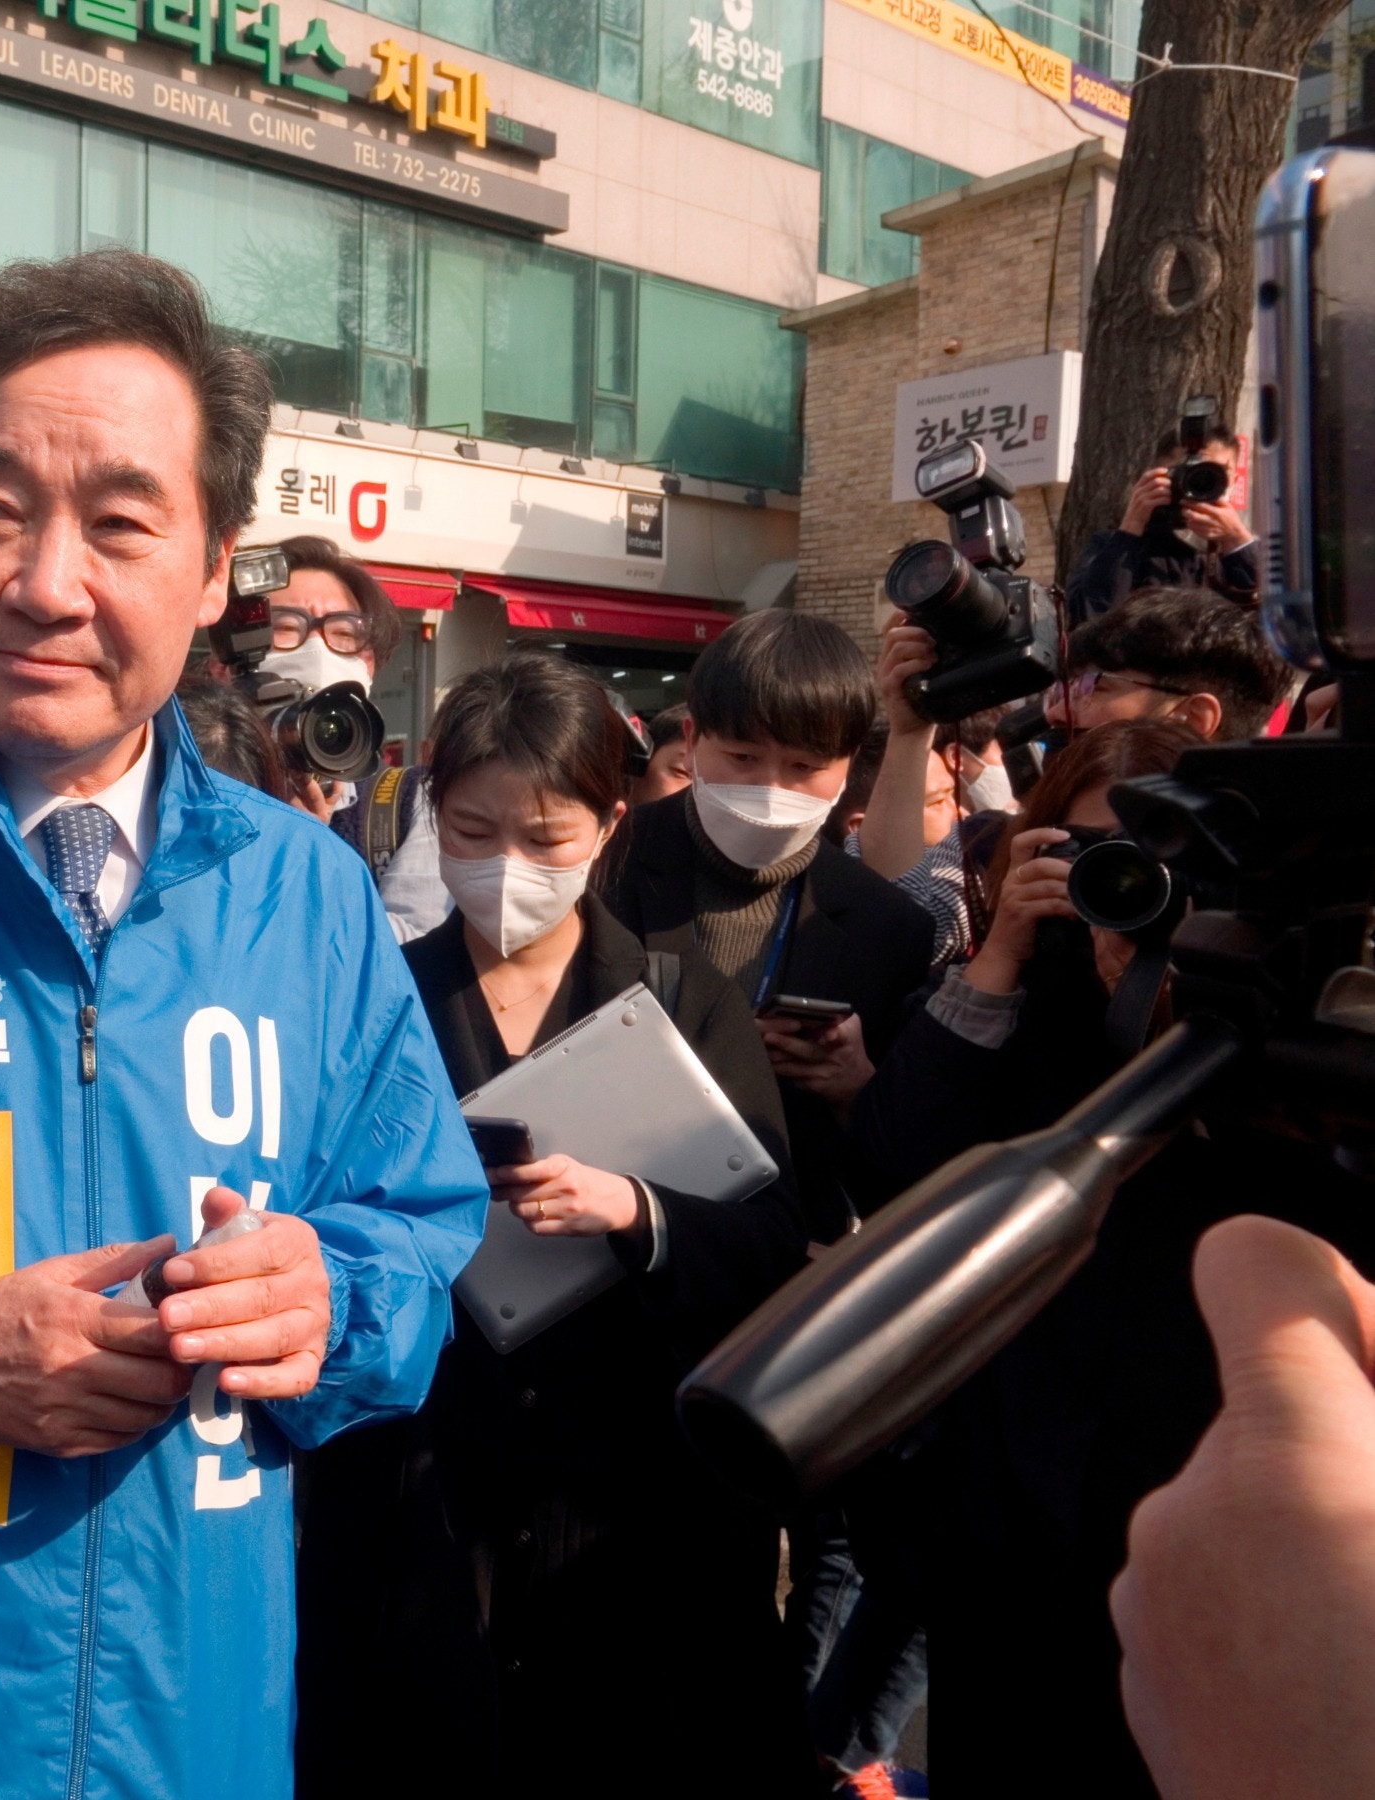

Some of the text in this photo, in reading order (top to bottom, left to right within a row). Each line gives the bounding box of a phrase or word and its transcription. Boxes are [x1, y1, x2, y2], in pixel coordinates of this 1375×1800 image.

[687, 16, 784, 90] 제중안과
[953, 15, 1006, 64] 교통사고
[1017, 46, 1065, 90] 다이어트
[370, 38, 493, 149] 치과
[495, 115, 524, 144] 의원
[697, 68, 773, 118] 542-8686
[40, 50, 135, 99] LEADERS
[154, 82, 232, 128] DENTAL
[250, 111, 317, 152] CLINIC
[353, 141, 386, 169] TEL:
[392, 153, 482, 198] 732-2275
[275, 466, 337, 516] 올레
[630, 502, 660, 517] mobile
[628, 534, 662, 551] internet
[640, 519, 651, 533] tv
[571, 611, 587, 628] kt
[695, 623, 707, 640] kt
